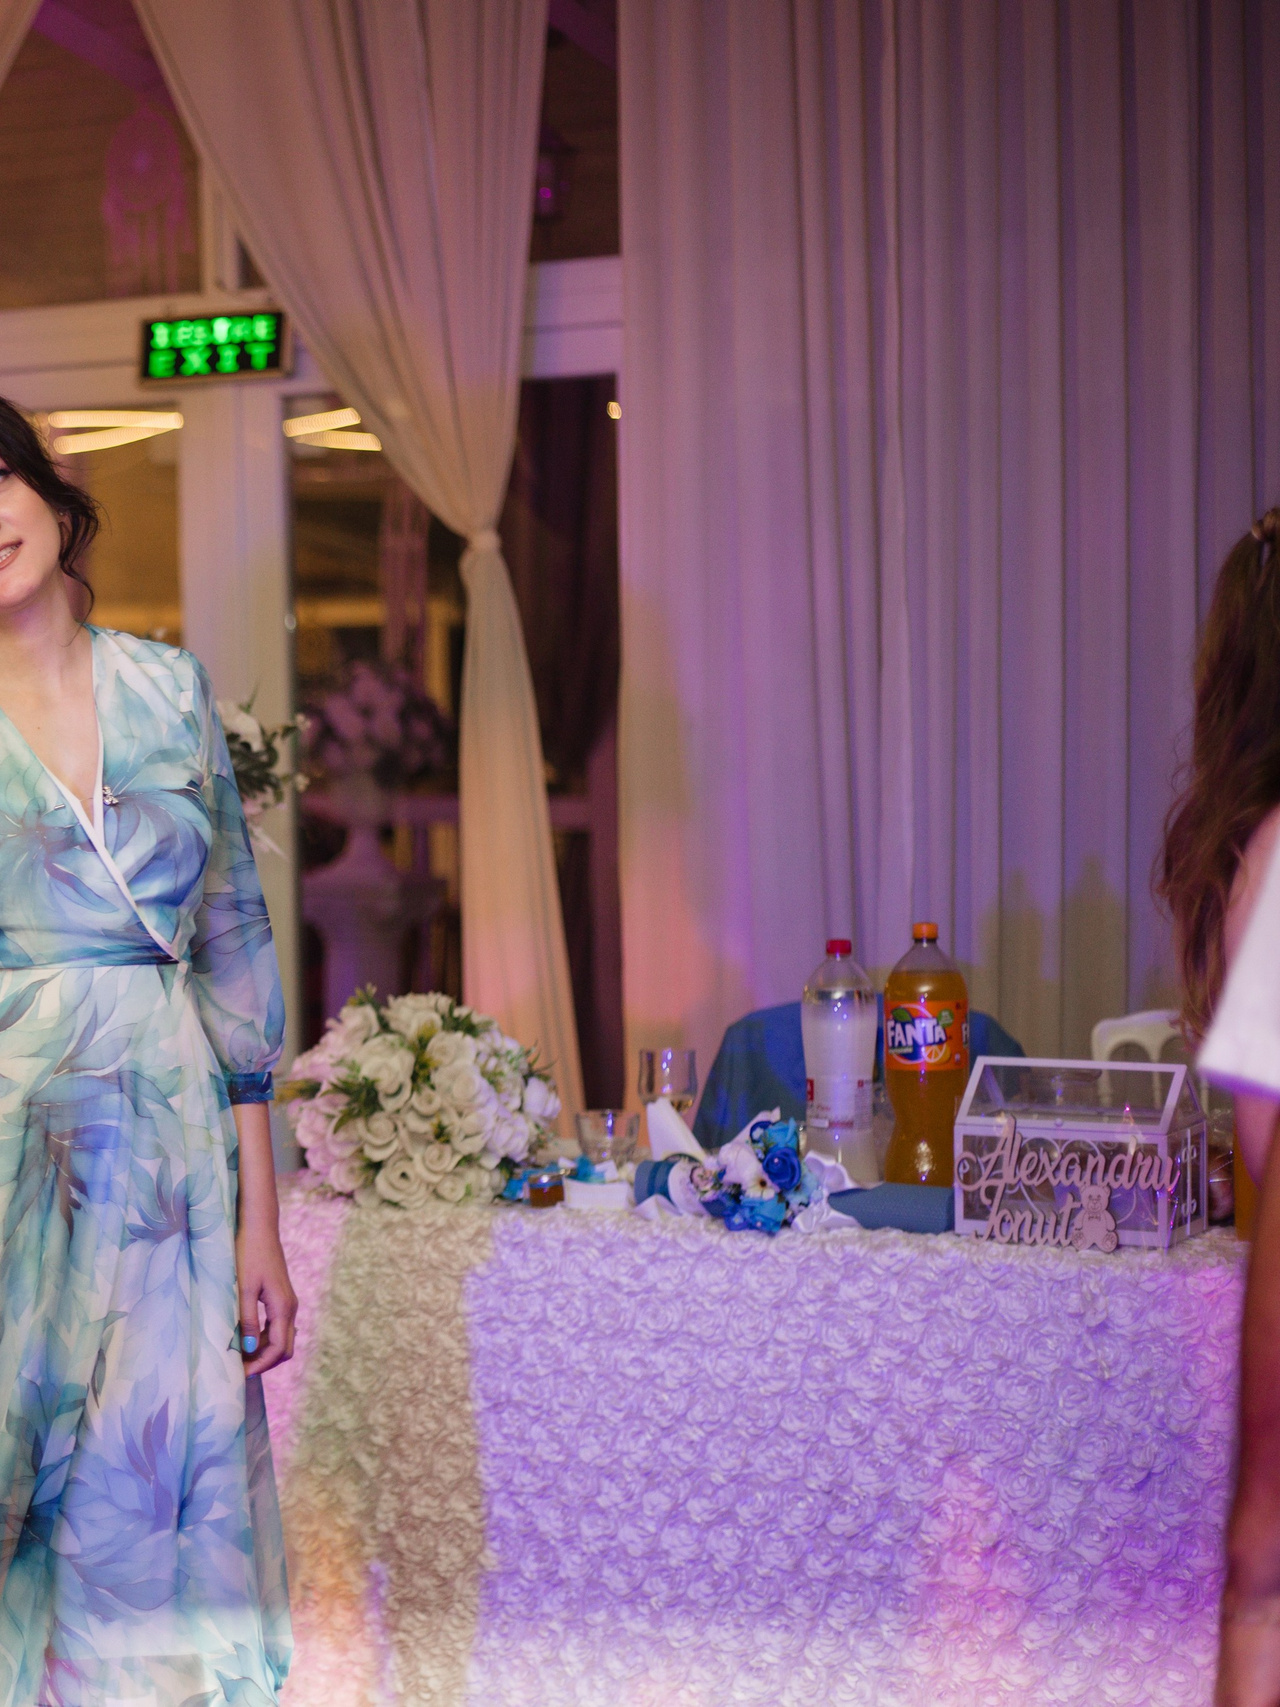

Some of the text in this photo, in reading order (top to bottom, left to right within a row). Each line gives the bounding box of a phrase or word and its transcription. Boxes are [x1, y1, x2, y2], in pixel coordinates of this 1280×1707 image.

[148, 342, 276, 379] EXIT
[887, 1018, 947, 1048] FANTA
[955, 1115, 1180, 1192] Alexandru
